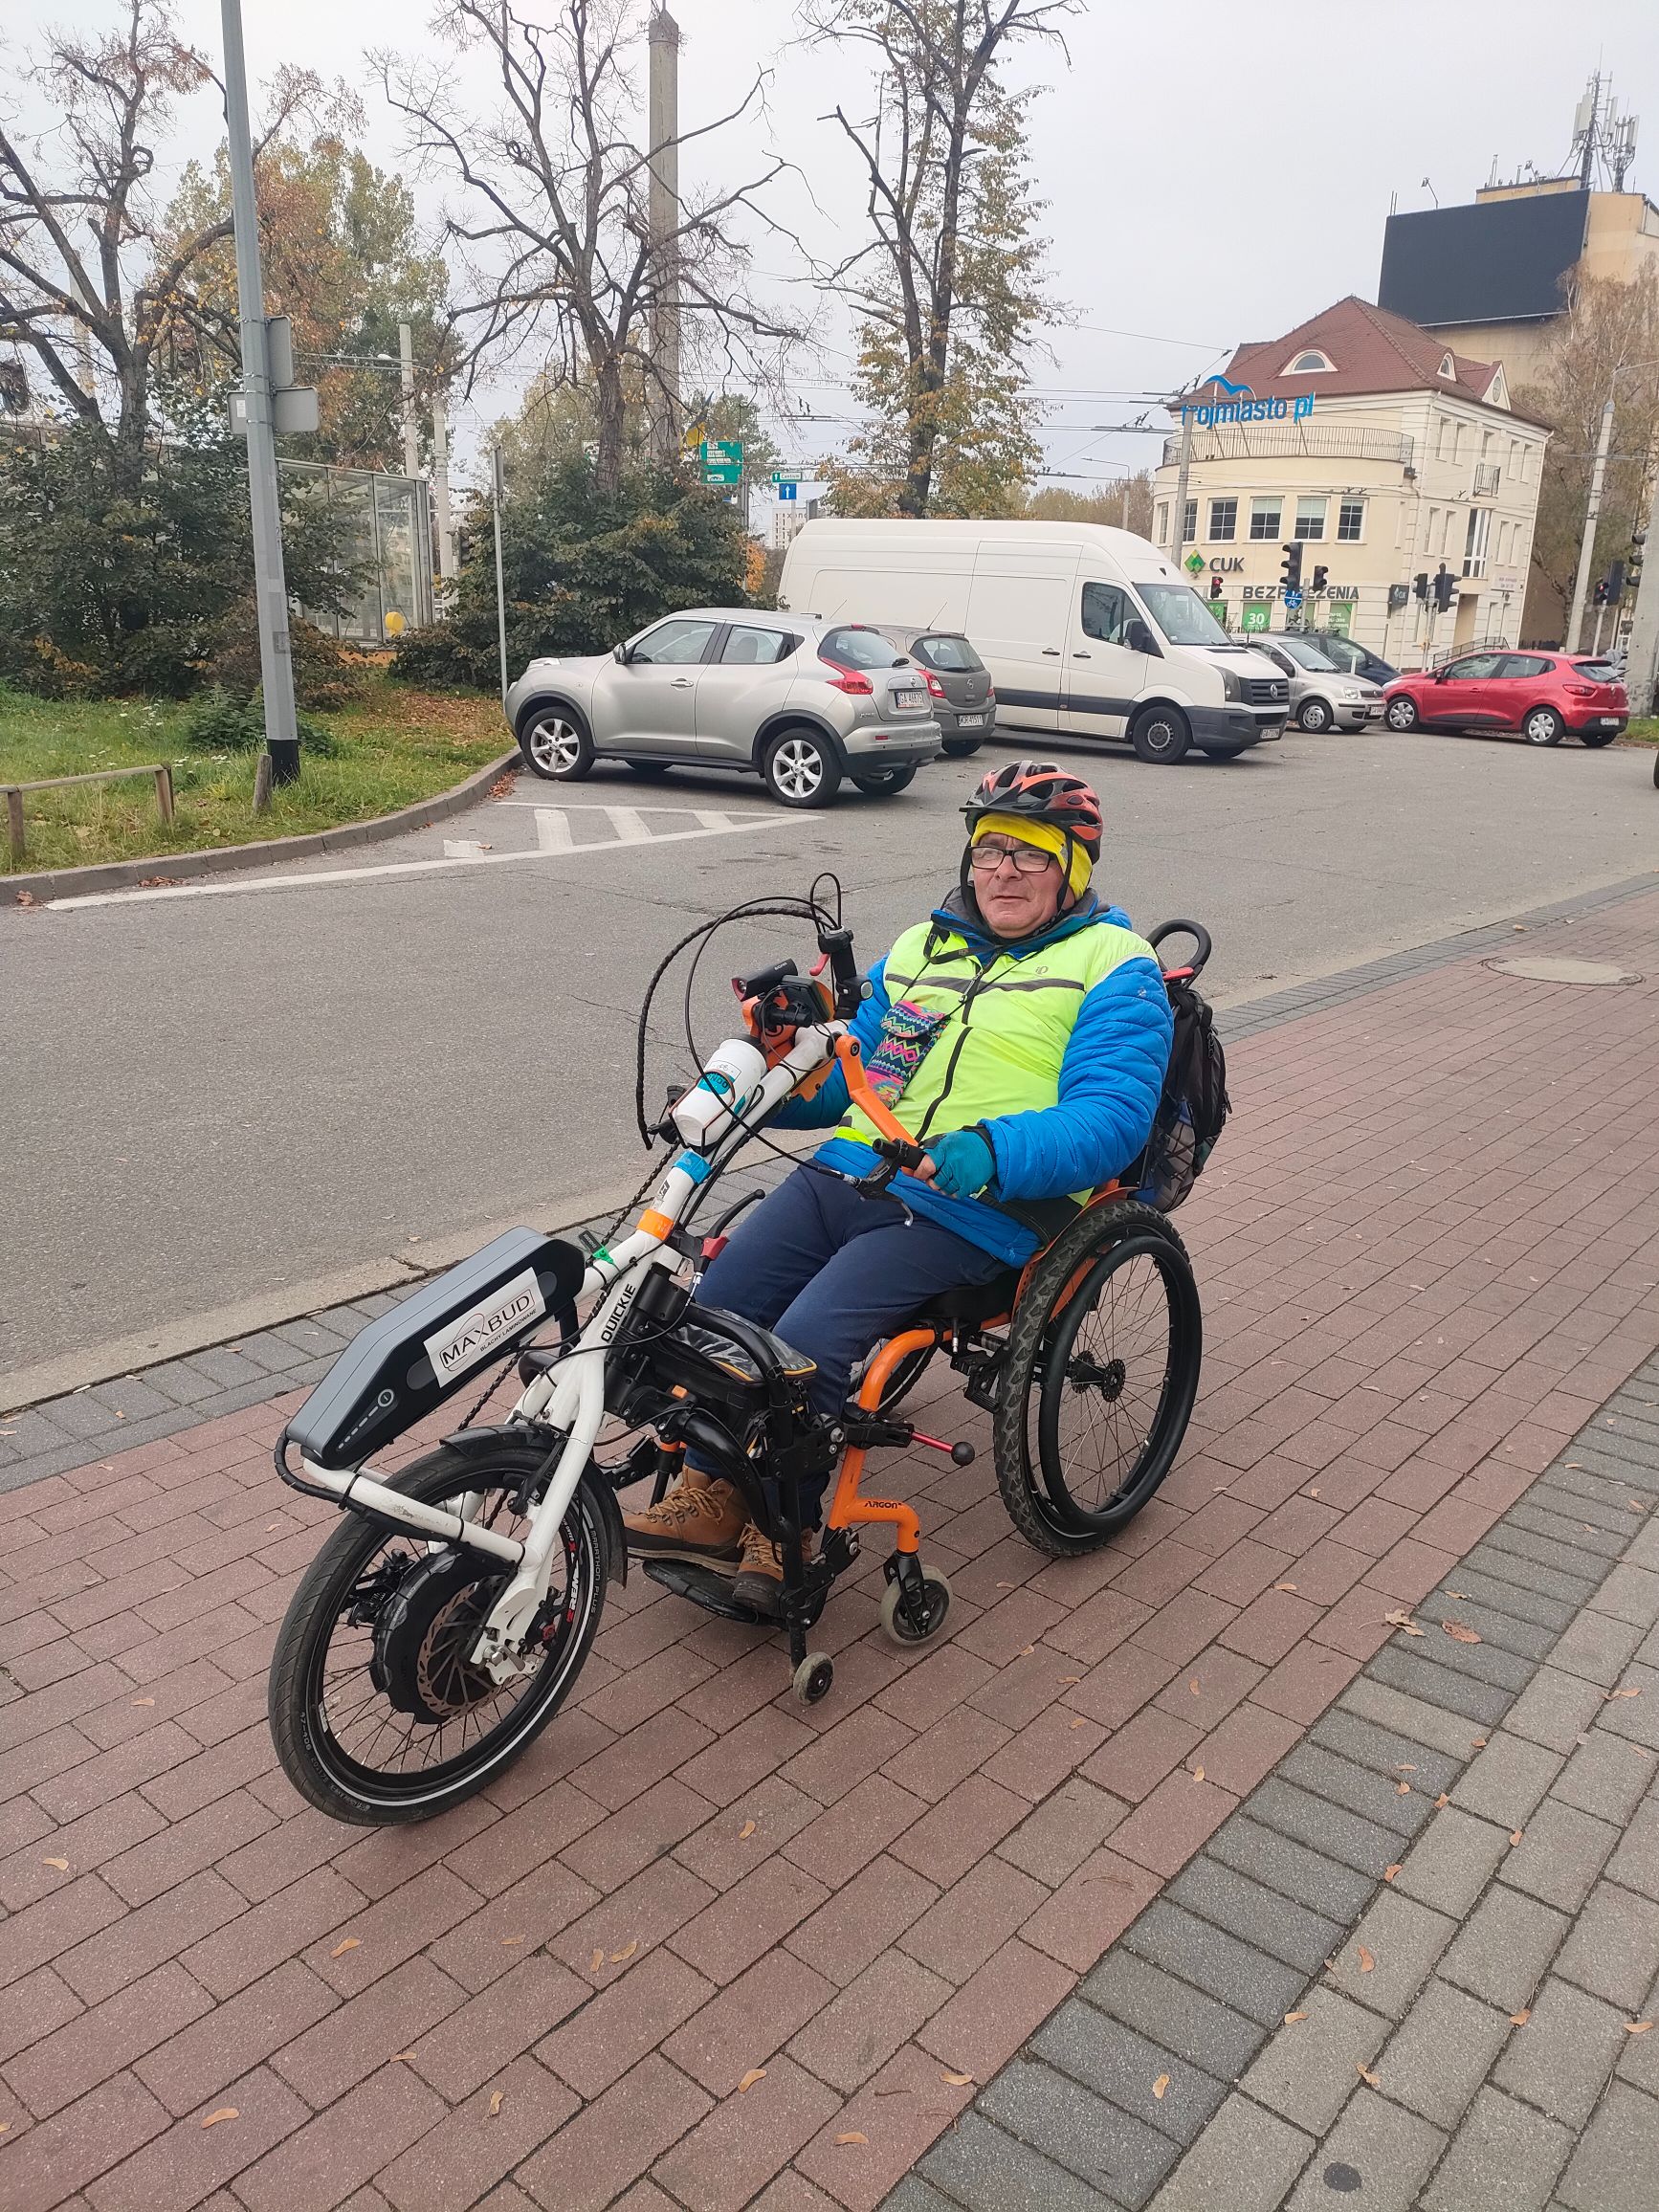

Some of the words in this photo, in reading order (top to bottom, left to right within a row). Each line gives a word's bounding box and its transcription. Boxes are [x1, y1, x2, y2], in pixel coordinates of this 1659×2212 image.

[1209, 557, 1245, 572] CUK
[1249, 612, 1265, 625] 30
[442, 1295, 530, 1364] MAXBUD
[479, 1335, 501, 1352] BLACHY
[502, 1309, 537, 1337] LAMINOWANE
[601, 1284, 635, 1342] QUICKIE
